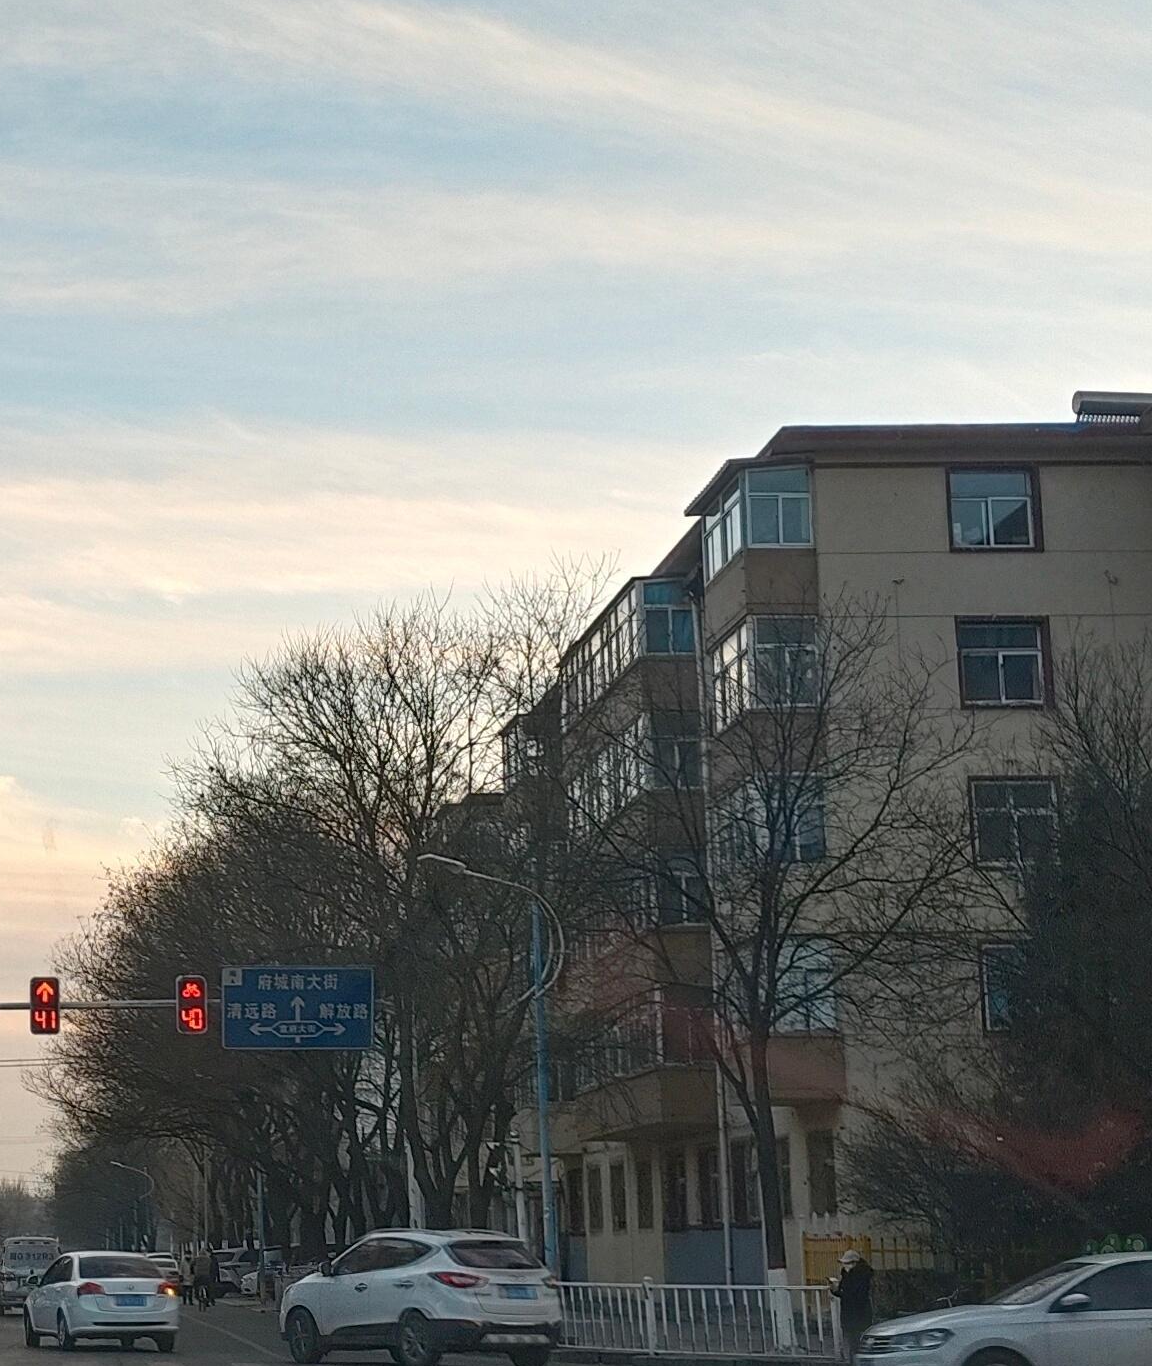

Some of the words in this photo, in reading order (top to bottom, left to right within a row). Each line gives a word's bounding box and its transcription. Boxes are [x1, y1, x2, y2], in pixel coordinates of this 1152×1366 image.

[258, 973, 338, 991] 府城南大街
[34, 1010, 56, 1029] 41
[181, 1008, 203, 1030] 40
[226, 1002, 277, 1020] 清远路
[319, 1002, 369, 1020] 解放路
